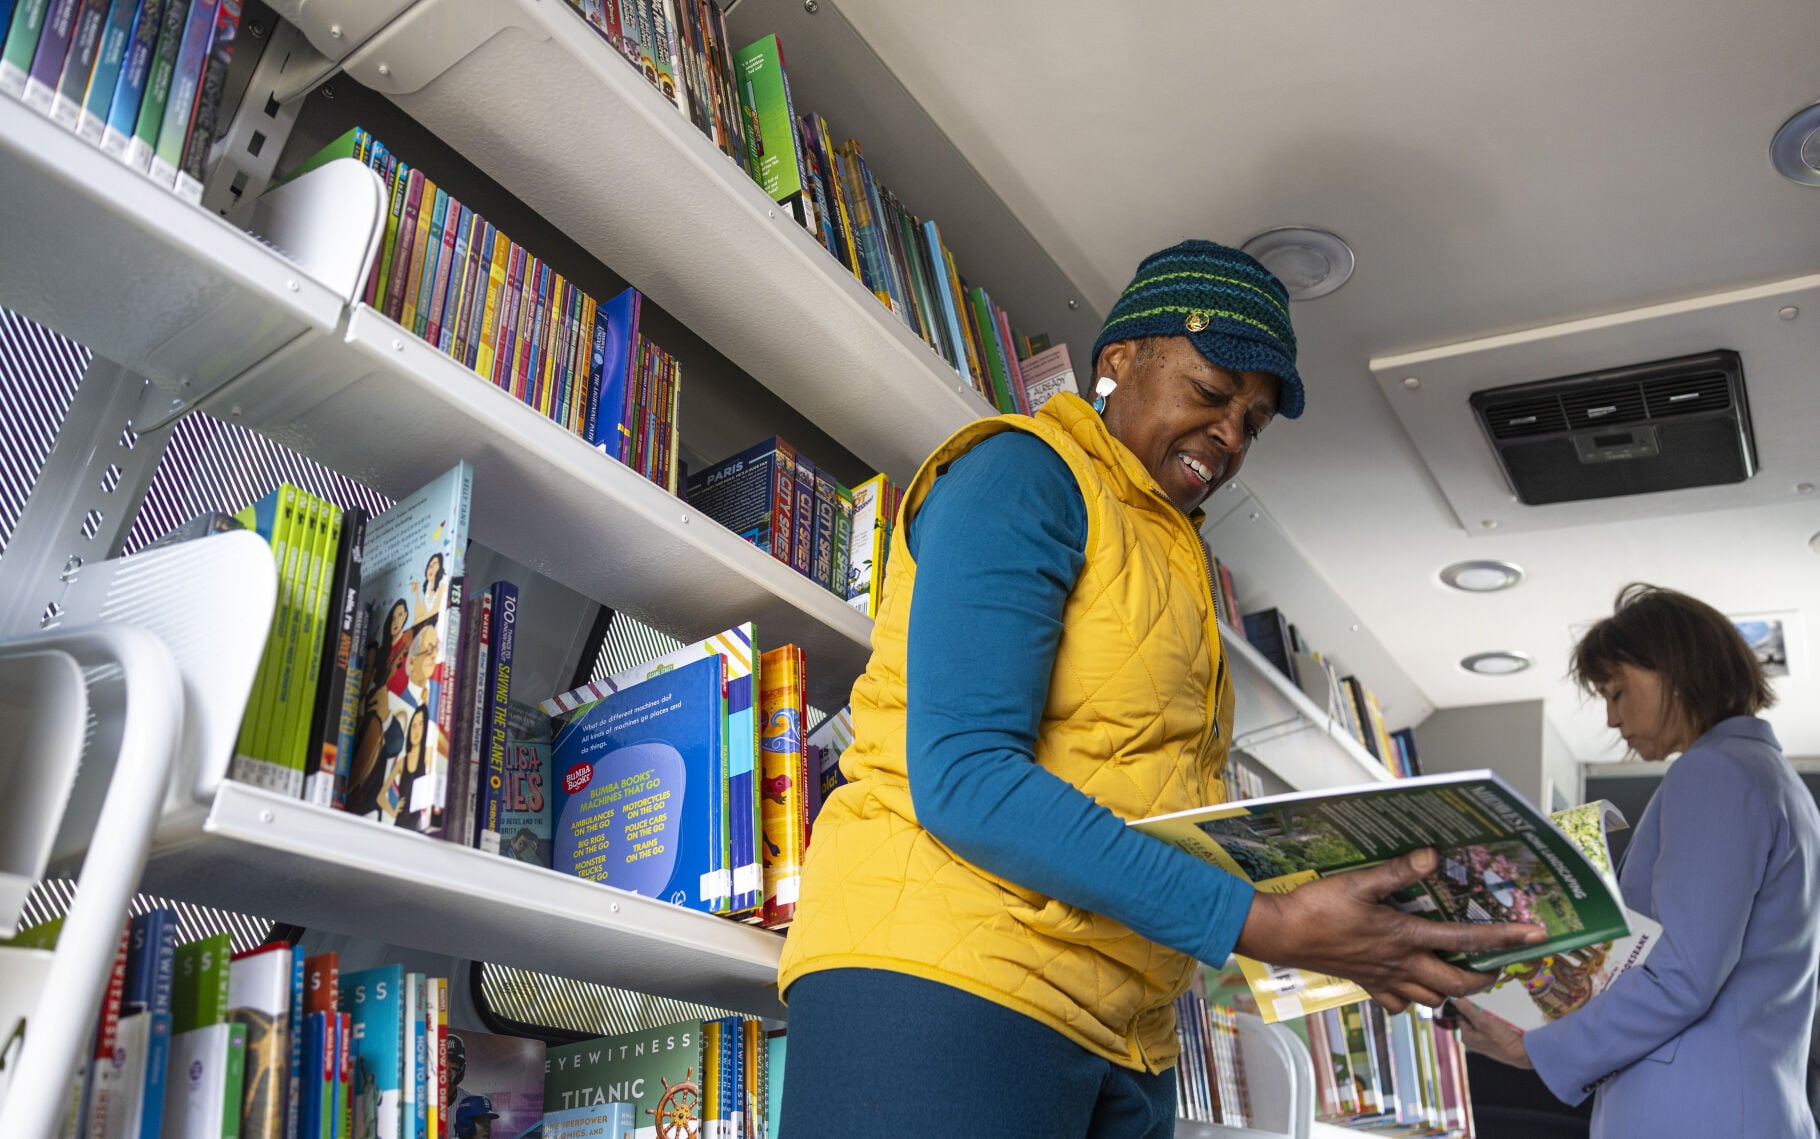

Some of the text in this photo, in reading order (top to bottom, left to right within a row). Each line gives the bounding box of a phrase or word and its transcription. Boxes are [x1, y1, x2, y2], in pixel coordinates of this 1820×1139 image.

[1033, 375, 1066, 396] ALREADY
[590, 385, 599, 423] LIGHTNING
[707, 461, 744, 485] PARIS
[459, 478, 469, 526] KELLY YANG
[778, 477, 792, 562] CITY SPIES
[798, 493, 812, 573] CITY SPIES
[818, 503, 832, 582] CITY SPIES
[838, 519, 850, 555] CITY
[835, 552, 848, 596] SPIES
[451, 584, 463, 605] YES
[503, 595, 517, 624] 100
[481, 613, 490, 640] WATER
[647, 665, 674, 680] SESAME STREET
[339, 667, 363, 735] STAMPED
[490, 662, 511, 774] SAVING THE PLANET
[582, 722, 598, 733] What
[600, 719, 607, 727] do
[608, 708, 633, 724] different
[634, 700, 660, 713] machines
[582, 701, 682, 743] All kinds of machines go places and
[505, 745, 542, 771] LISA
[581, 741, 607, 755] do things.
[566, 765, 591, 783] BUMBA
[567, 774, 591, 791] BOOKS
[580, 778, 660, 812] MACHINES THAT GO
[590, 782, 619, 799] BUMBA
[622, 790, 671, 813] MOTORCYCLES
[571, 809, 615, 830] AMBULANCES
[627, 801, 665, 819] ON THE GO
[574, 819, 610, 837] ON THE GO
[624, 814, 667, 833] POLICE CARS
[626, 823, 664, 841] ON THE GO
[573, 841, 609, 858] ON THE GO
[578, 834, 605, 848] BIG RIGS
[633, 838, 658, 853] TRAINS
[1472, 785, 1535, 832] MIDWEST
[1541, 850, 1587, 900] LANDSCAPING
[575, 855, 607, 871] MONSTER
[626, 845, 664, 863] ON THE GO
[578, 865, 603, 878] TRUCKS
[597, 871, 609, 881] GO
[544, 1032, 691, 1074] EYEWITNESS
[416, 1035, 425, 1120] HOW TO DRAW
[438, 1038, 447, 1121] HOW TO DRAW
[562, 1078, 645, 1110] TITANIC
[555, 1115, 608, 1129] SUPERPOWER
[589, 1128, 603, 1136] AND
